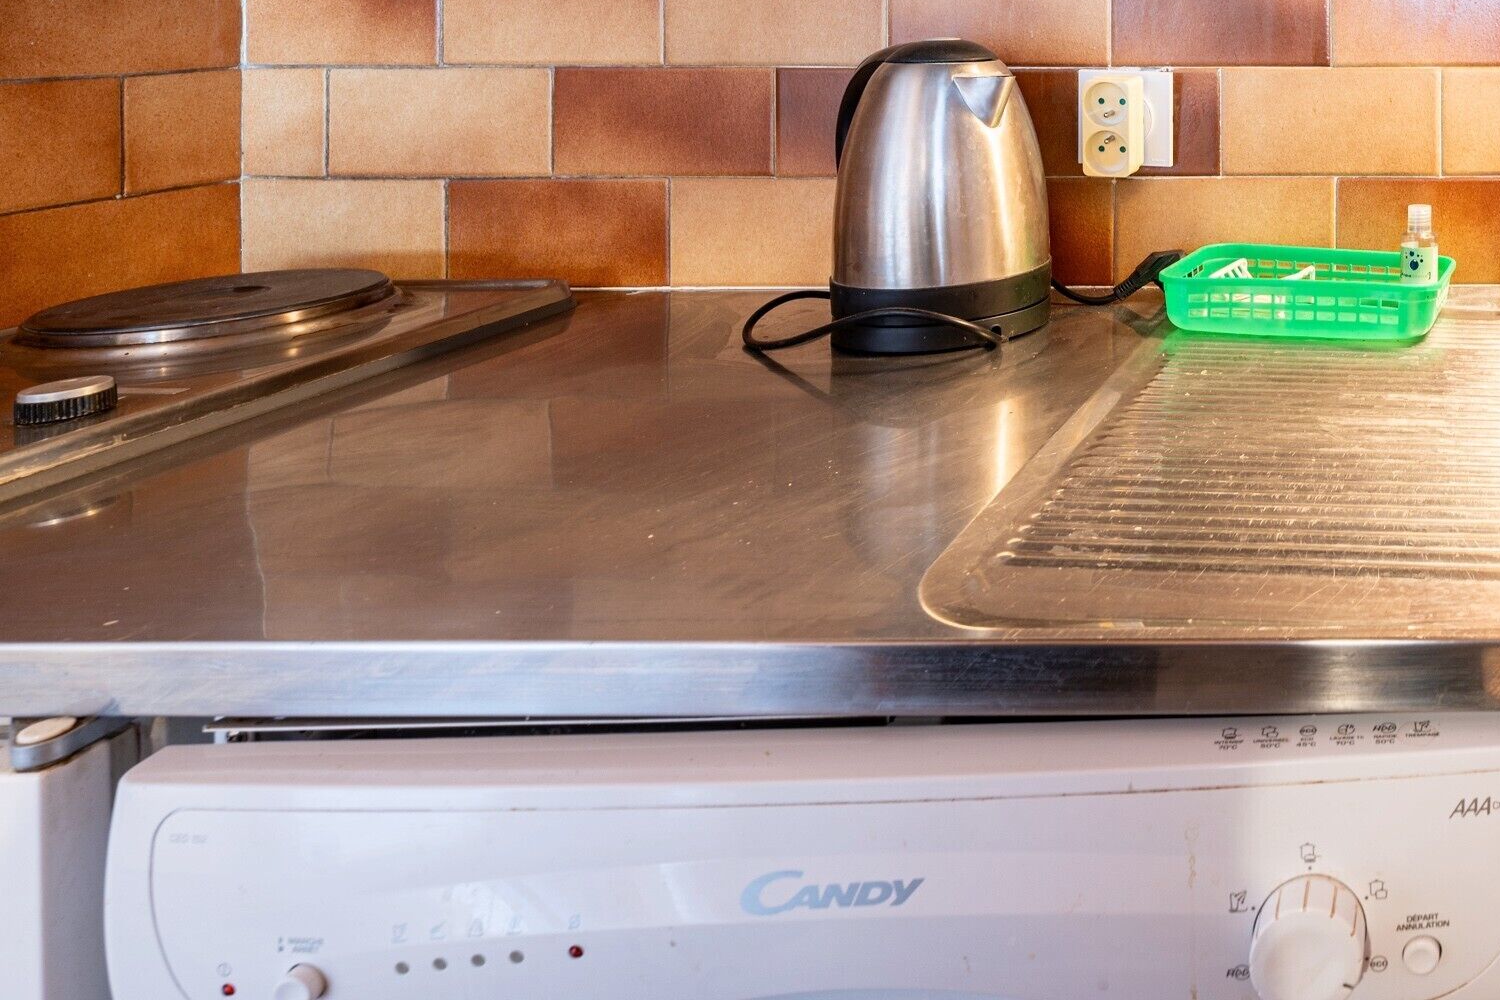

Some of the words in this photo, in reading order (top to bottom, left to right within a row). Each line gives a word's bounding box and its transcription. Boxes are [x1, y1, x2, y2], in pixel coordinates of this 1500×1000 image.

[1449, 796, 1491, 819] AAA
[1405, 913, 1439, 923] DÉPART
[1396, 920, 1450, 931] ANNULATION
